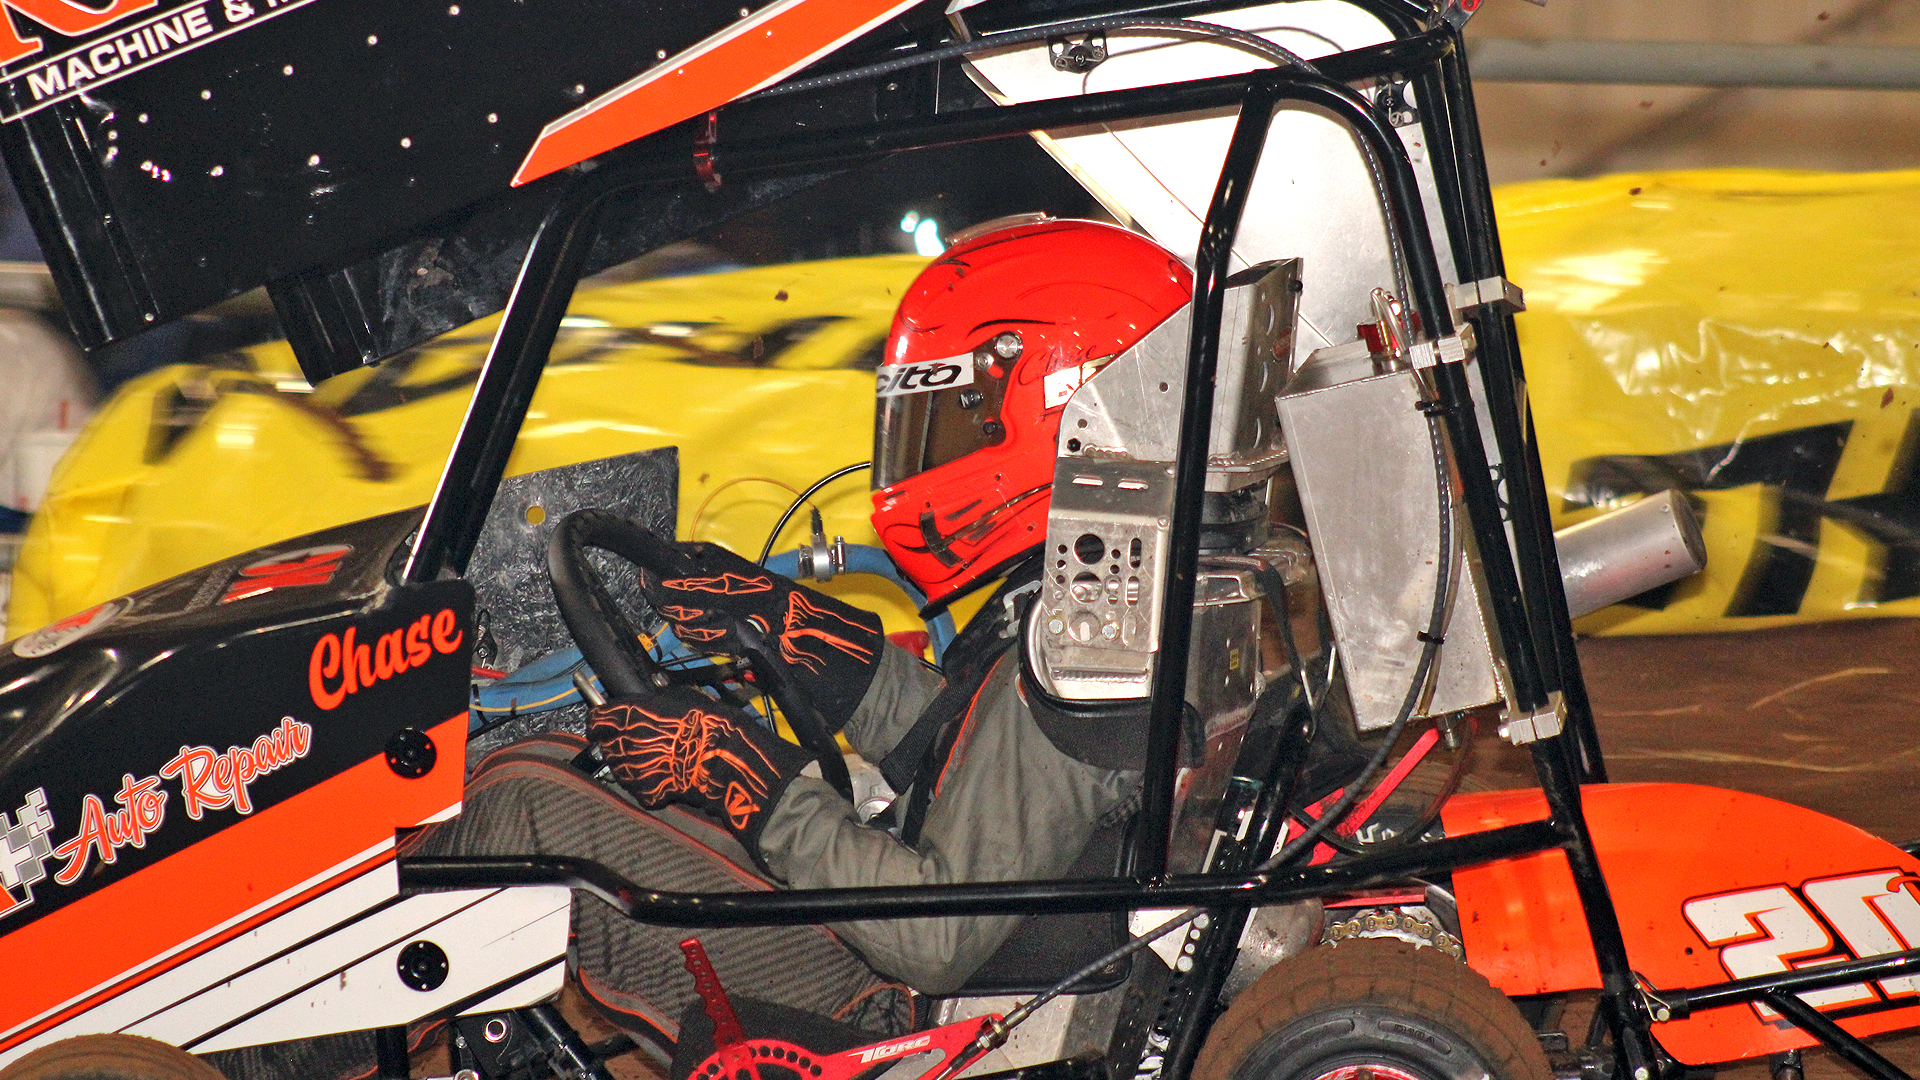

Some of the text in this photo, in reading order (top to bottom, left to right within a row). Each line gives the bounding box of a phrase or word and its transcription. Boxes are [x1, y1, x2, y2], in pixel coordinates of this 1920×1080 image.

[26, 7, 213, 100] MACHINE
[308, 608, 463, 710] Chase
[53, 716, 311, 883] Auto Repair
[848, 1035, 930, 1064] TORC
